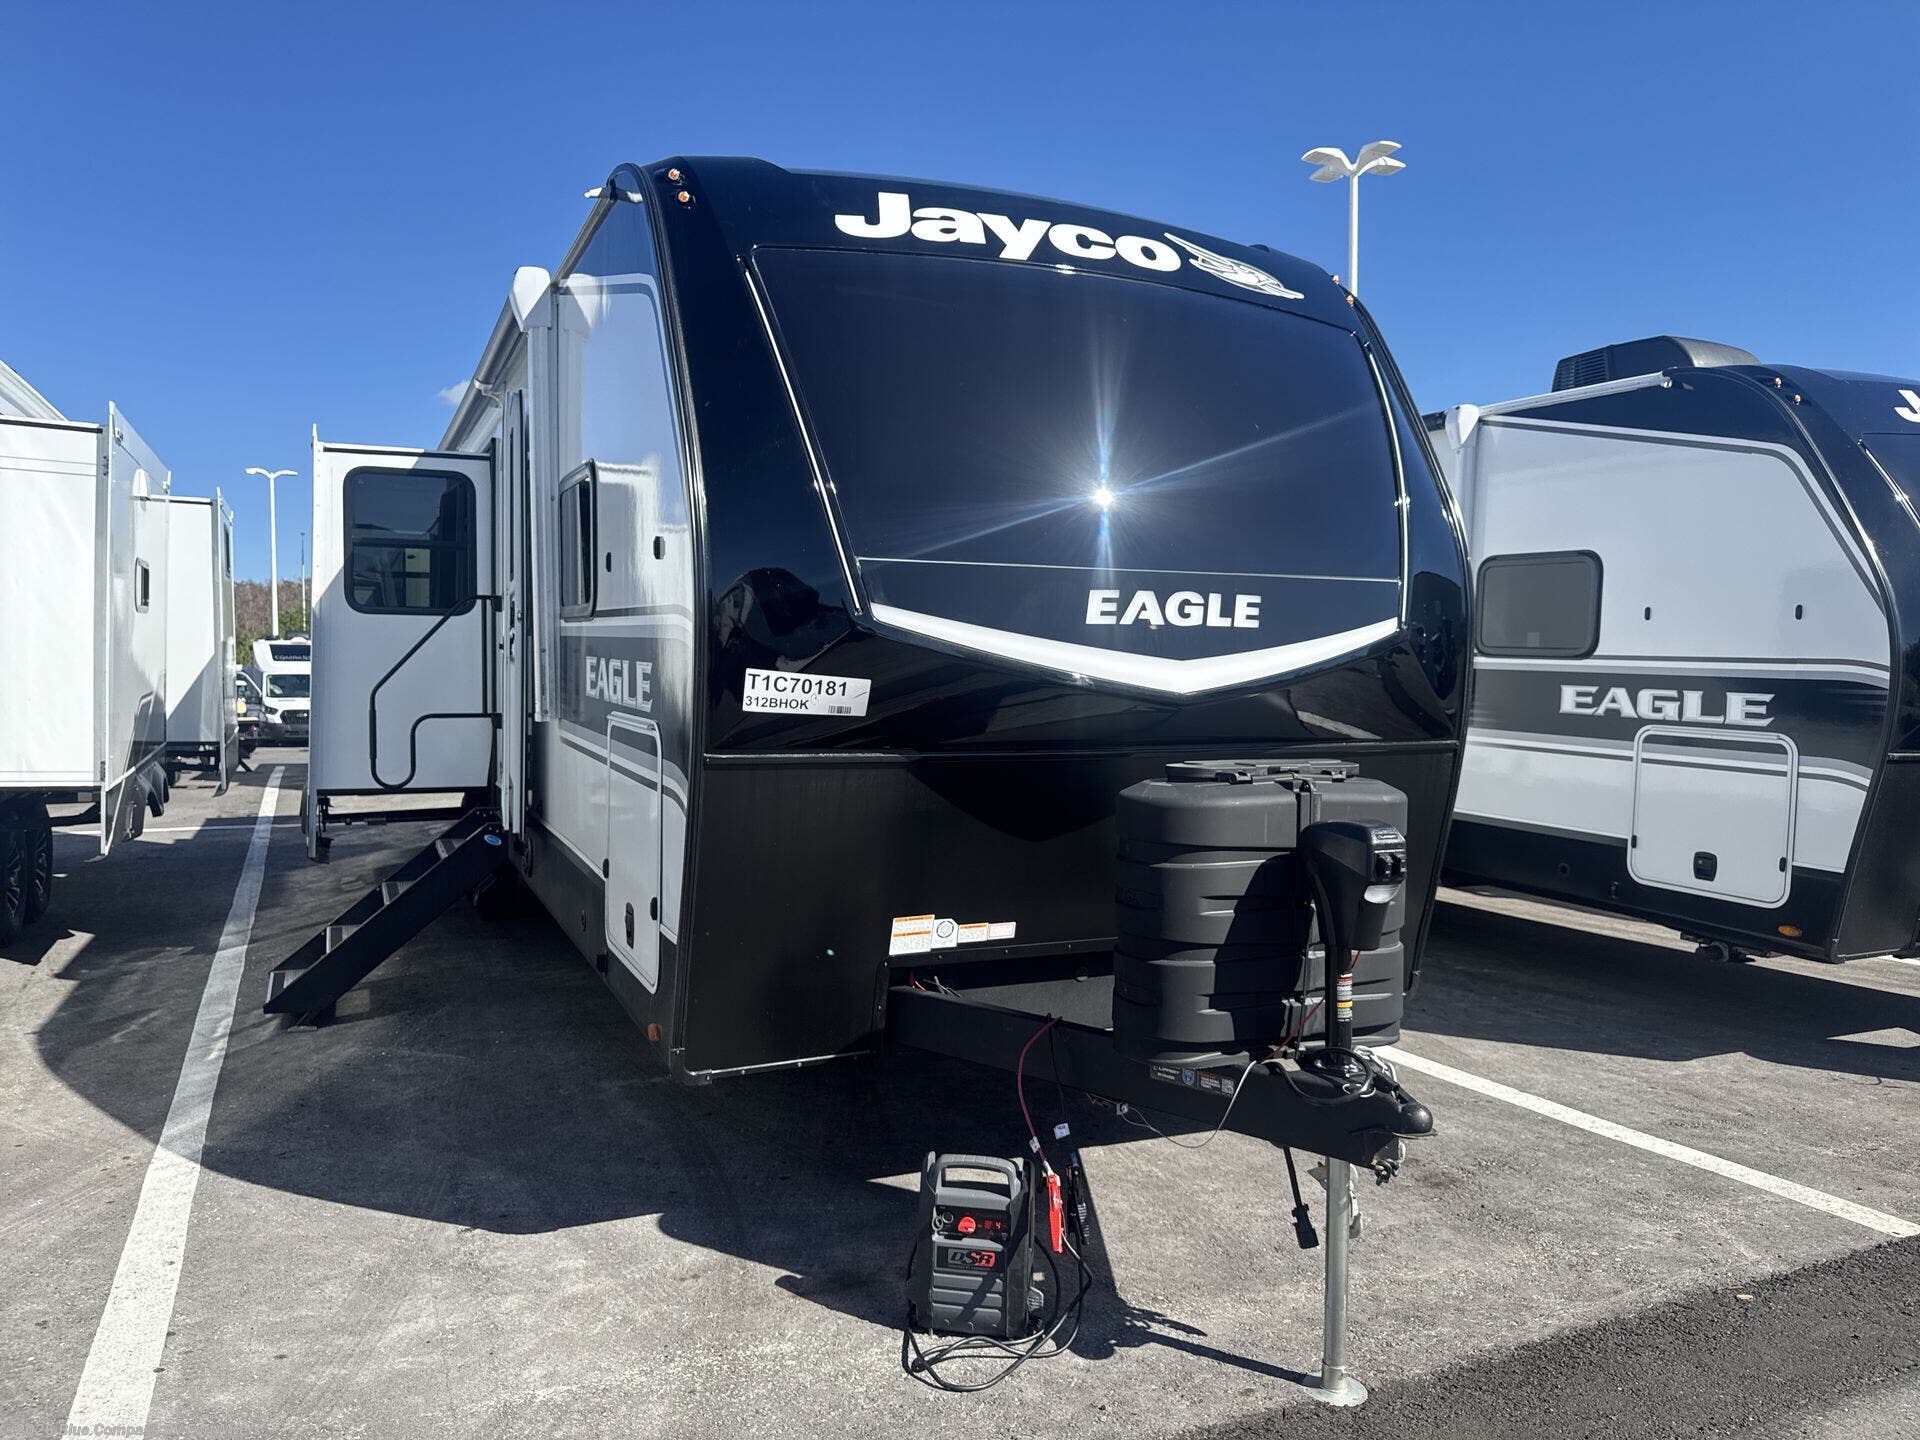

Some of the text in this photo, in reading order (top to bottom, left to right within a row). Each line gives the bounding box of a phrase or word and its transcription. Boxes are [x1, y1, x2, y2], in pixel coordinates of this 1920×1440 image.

[834, 191, 1182, 273] Jayco
[1085, 589, 1262, 629] EAGLE
[585, 655, 653, 713] EAGLE
[745, 695, 809, 710] 312BHOK
[747, 673, 847, 696] T1C70181
[1558, 684, 1776, 727] EAGLE
